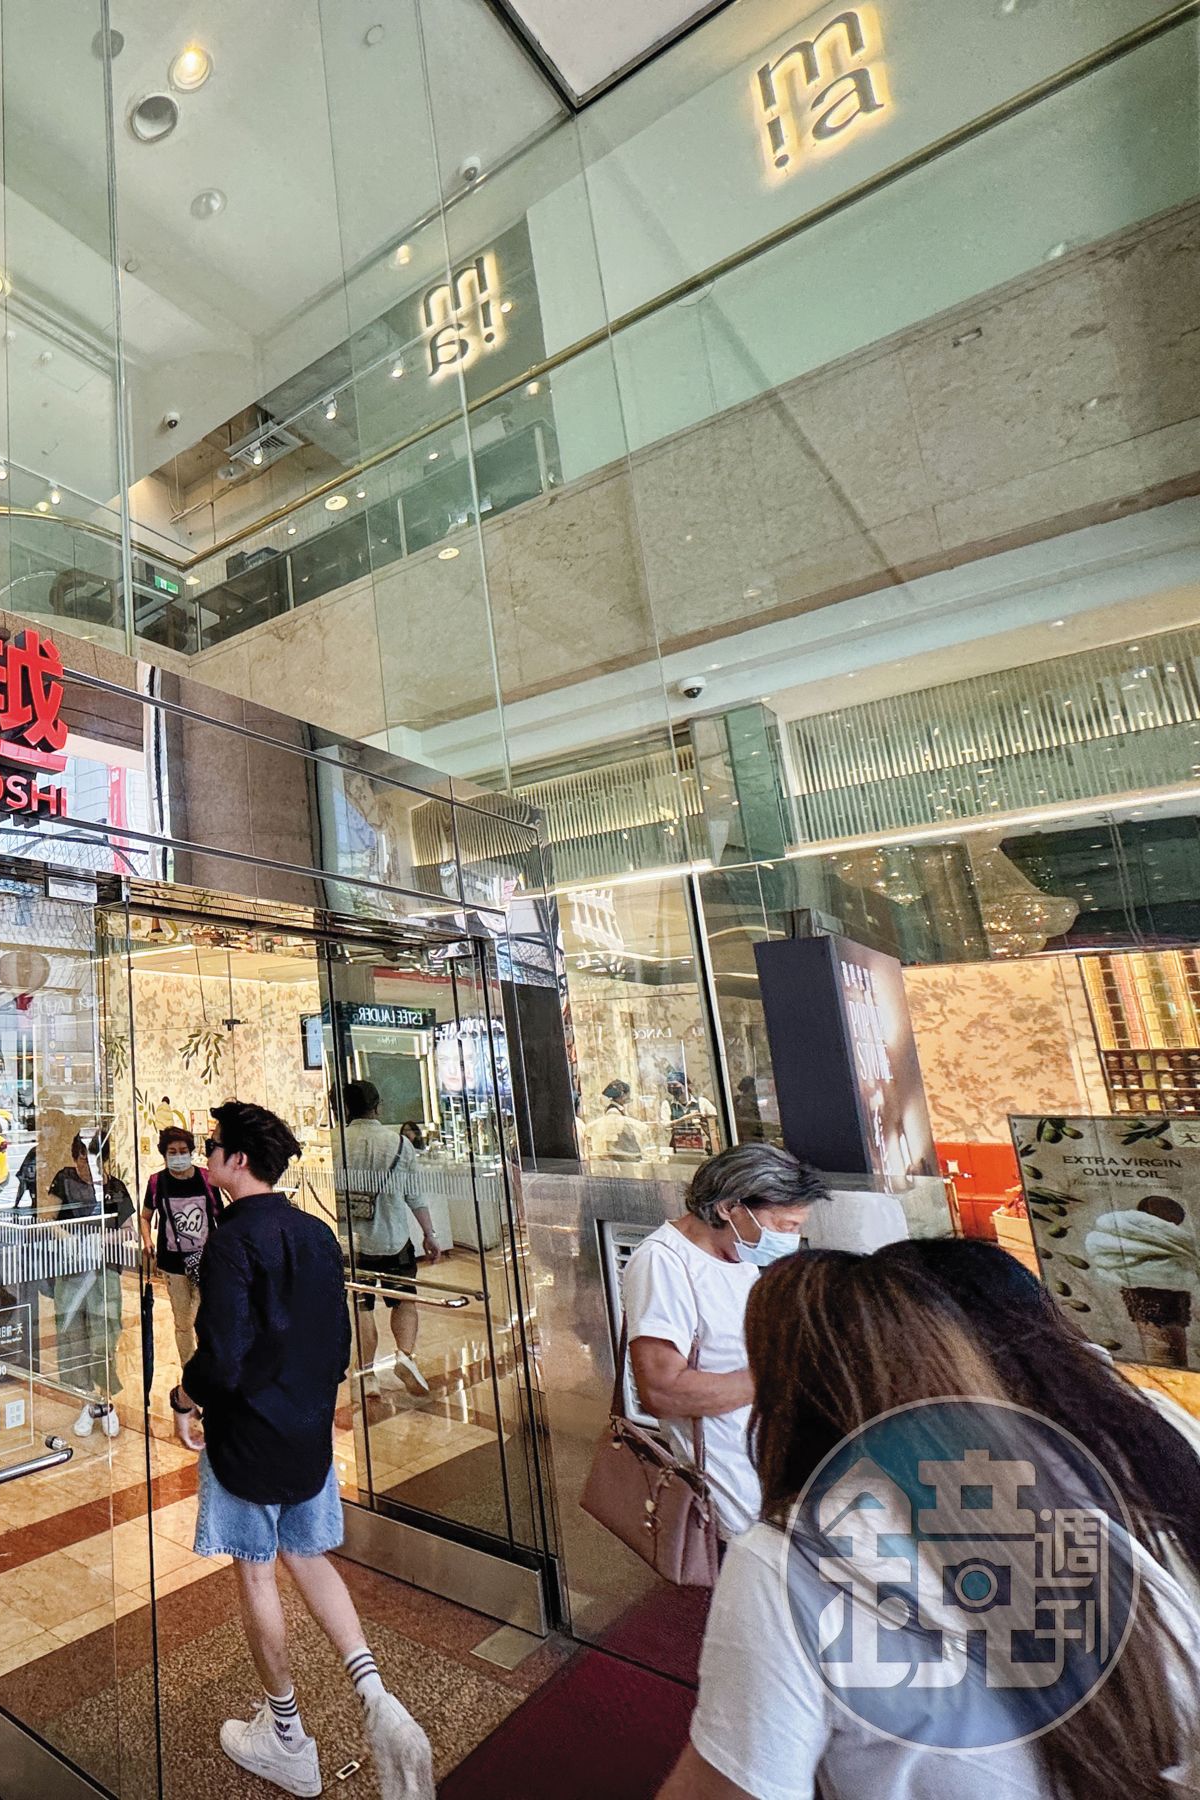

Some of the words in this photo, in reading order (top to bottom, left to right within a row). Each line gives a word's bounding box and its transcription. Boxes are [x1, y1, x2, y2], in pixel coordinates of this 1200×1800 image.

[1063, 1155, 1118, 1166] EXTRA
[1121, 1157, 1183, 1168] VIRGIN
[1082, 1167, 1136, 1178] OLIVE
[1136, 1170, 1166, 1180] OIL
